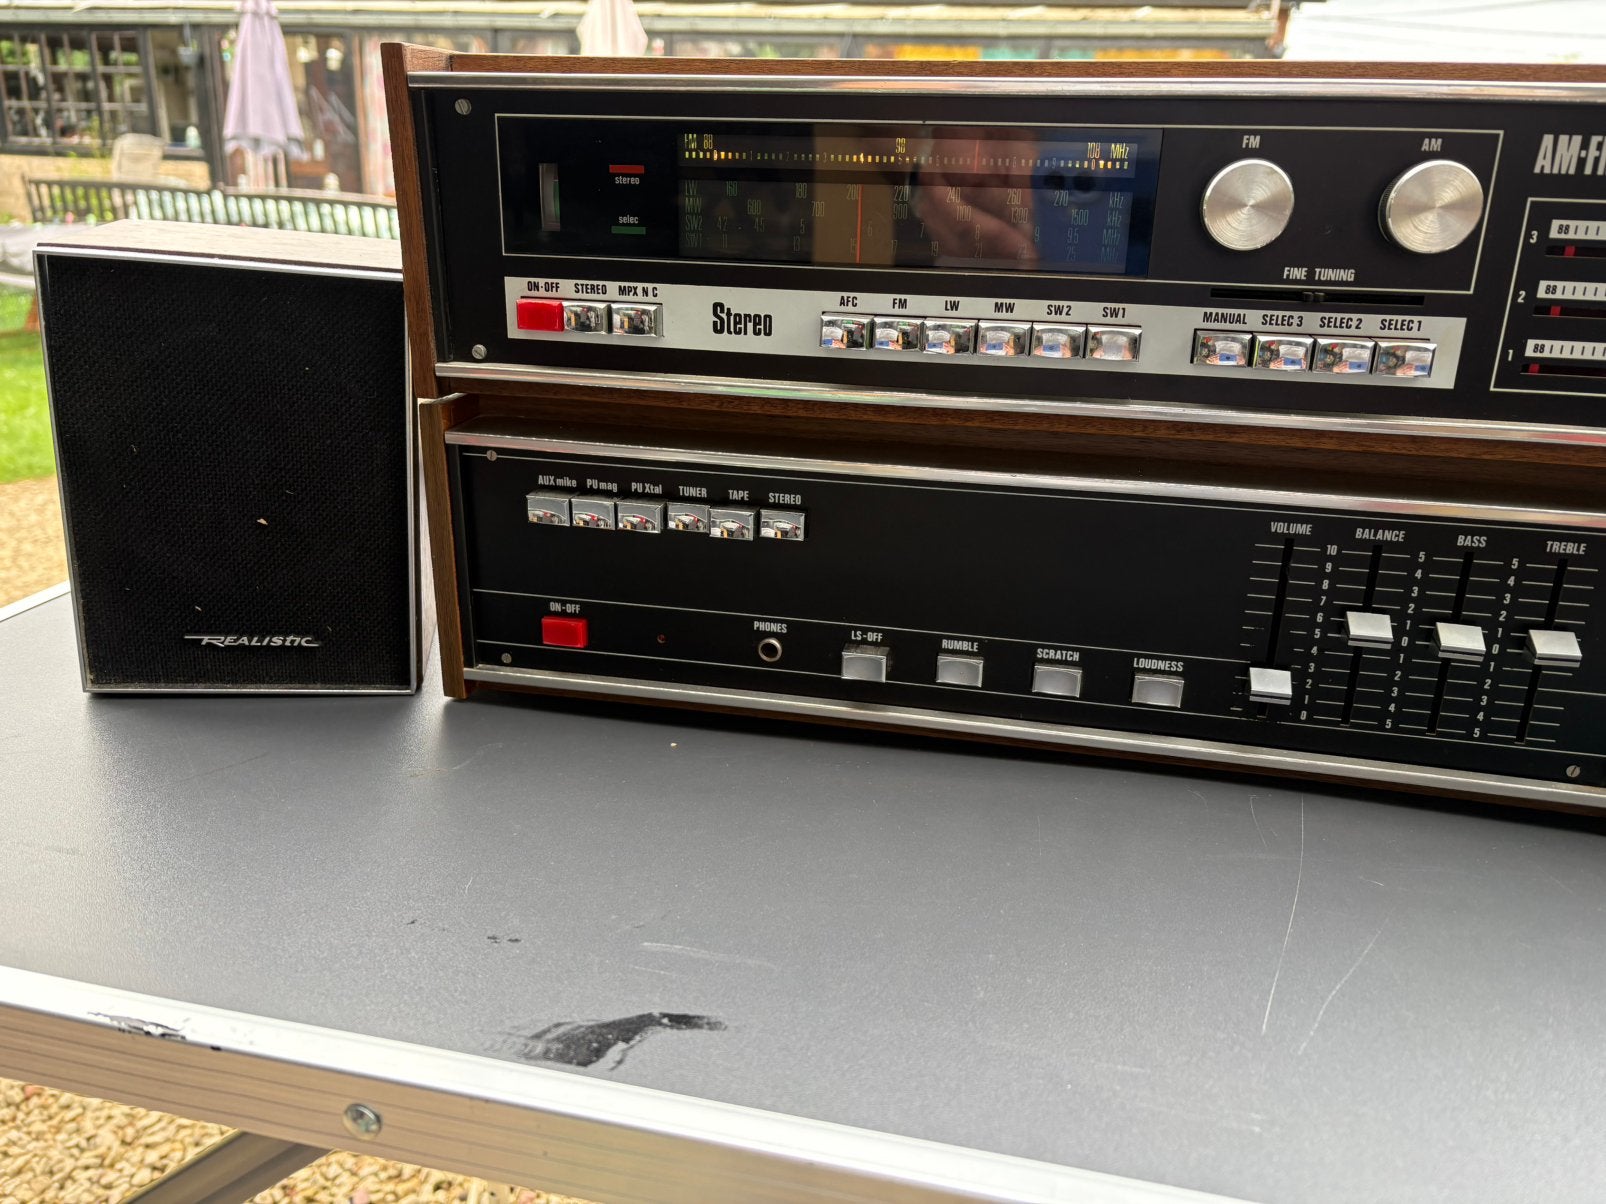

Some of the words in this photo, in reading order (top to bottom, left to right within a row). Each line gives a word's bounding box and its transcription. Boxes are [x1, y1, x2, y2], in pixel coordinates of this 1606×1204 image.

[1242, 135, 1260, 148] FM
[1421, 138, 1442, 151] AM
[1088, 142, 1100, 158] 108
[1110, 143, 1129, 159] MHz
[615, 176, 640, 185] stereo
[946, 188, 960, 203] 240
[1007, 189, 1022, 205] 260
[1054, 191, 1068, 206] 270
[1110, 192, 1124, 208] kHz
[618, 214, 639, 224] selec
[1071, 210, 1089, 226] 1500
[1107, 211, 1121, 227] kHz
[1557, 224, 1570, 235] 88
[1530, 231, 1538, 243] 3
[1284, 267, 1307, 280] FINE
[1315, 268, 1355, 281] TUNING
[574, 283, 607, 295] STEREO
[618, 285, 638, 297] MPX
[642, 287, 649, 297] N
[652, 287, 658, 297] C
[1545, 285, 1557, 295] 88
[839, 296, 858, 308] AFC
[1518, 291, 1526, 302] 2
[892, 298, 907, 310] FM
[944, 300, 960, 312] LW
[994, 302, 1015, 313] MW
[712, 302, 772, 336] Stereo
[1202, 312, 1248, 325] MANUAL
[1261, 314, 1295, 326] SELEC
[1297, 316, 1303, 327] 3
[1319, 317, 1353, 329] SELEC
[1355, 318, 1363, 330] 2
[1380, 319, 1414, 332] SELEC
[1417, 320, 1422, 332] 1
[1533, 343, 1546, 354] 88
[1508, 350, 1514, 361] 1
[538, 475, 555, 486] AUX
[556, 476, 577, 488] mike
[587, 479, 599, 490] PU
[599, 481, 618, 493] mag
[631, 482, 644, 493] PU
[645, 483, 662, 494] Xtal
[678, 486, 707, 498] TUNER
[728, 490, 749, 501] TAPE
[768, 493, 802, 505] STEREO
[1270, 522, 1312, 535] VOLUME
[1355, 528, 1405, 542] BALANCE
[1457, 535, 1487, 547] BASS
[1326, 545, 1338, 555] 10
[1546, 541, 1587, 555] TREBLE
[1418, 552, 1425, 562] 5
[1325, 563, 1332, 572] 9
[1512, 558, 1519, 568] 5
[1415, 569, 1422, 579] 4
[1322, 580, 1329, 589] 8
[1508, 576, 1515, 586] 4
[1411, 587, 1418, 597] 3
[1320, 596, 1326, 606] 7
[1504, 593, 1511, 604] 3
[550, 602, 580, 614] ON-OFF
[1407, 604, 1415, 614] 2
[1316, 613, 1323, 622] 6
[1499, 611, 1507, 620] 2
[754, 621, 787, 633] PHONES
[1406, 620, 1410, 630] 1
[852, 631, 883, 642] LS-OFF
[1314, 629, 1321, 638] 5
[1498, 628, 1502, 638] 1
[942, 639, 978, 652] RUMBLE
[1401, 637, 1409, 646] 0
[1311, 646, 1318, 655] 4
[1492, 644, 1499, 654] 0
[1037, 648, 1079, 662] SCRATCH
[1400, 654, 1404, 663] 1
[1133, 658, 1184, 672] LOUDNESS
[1308, 663, 1315, 672] 3
[1490, 662, 1494, 672] 1
[1394, 671, 1401, 680] 2
[1306, 679, 1312, 688] 2
[1484, 679, 1491, 688] 2
[1391, 687, 1398, 696] 3
[1304, 696, 1308, 704] 1
[1481, 696, 1488, 705] 3
[1388, 703, 1395, 712] 4
[1300, 711, 1307, 720] 0
[1477, 712, 1484, 721] 4
[1385, 719, 1392, 729] 5
[1473, 728, 1480, 737] 5
